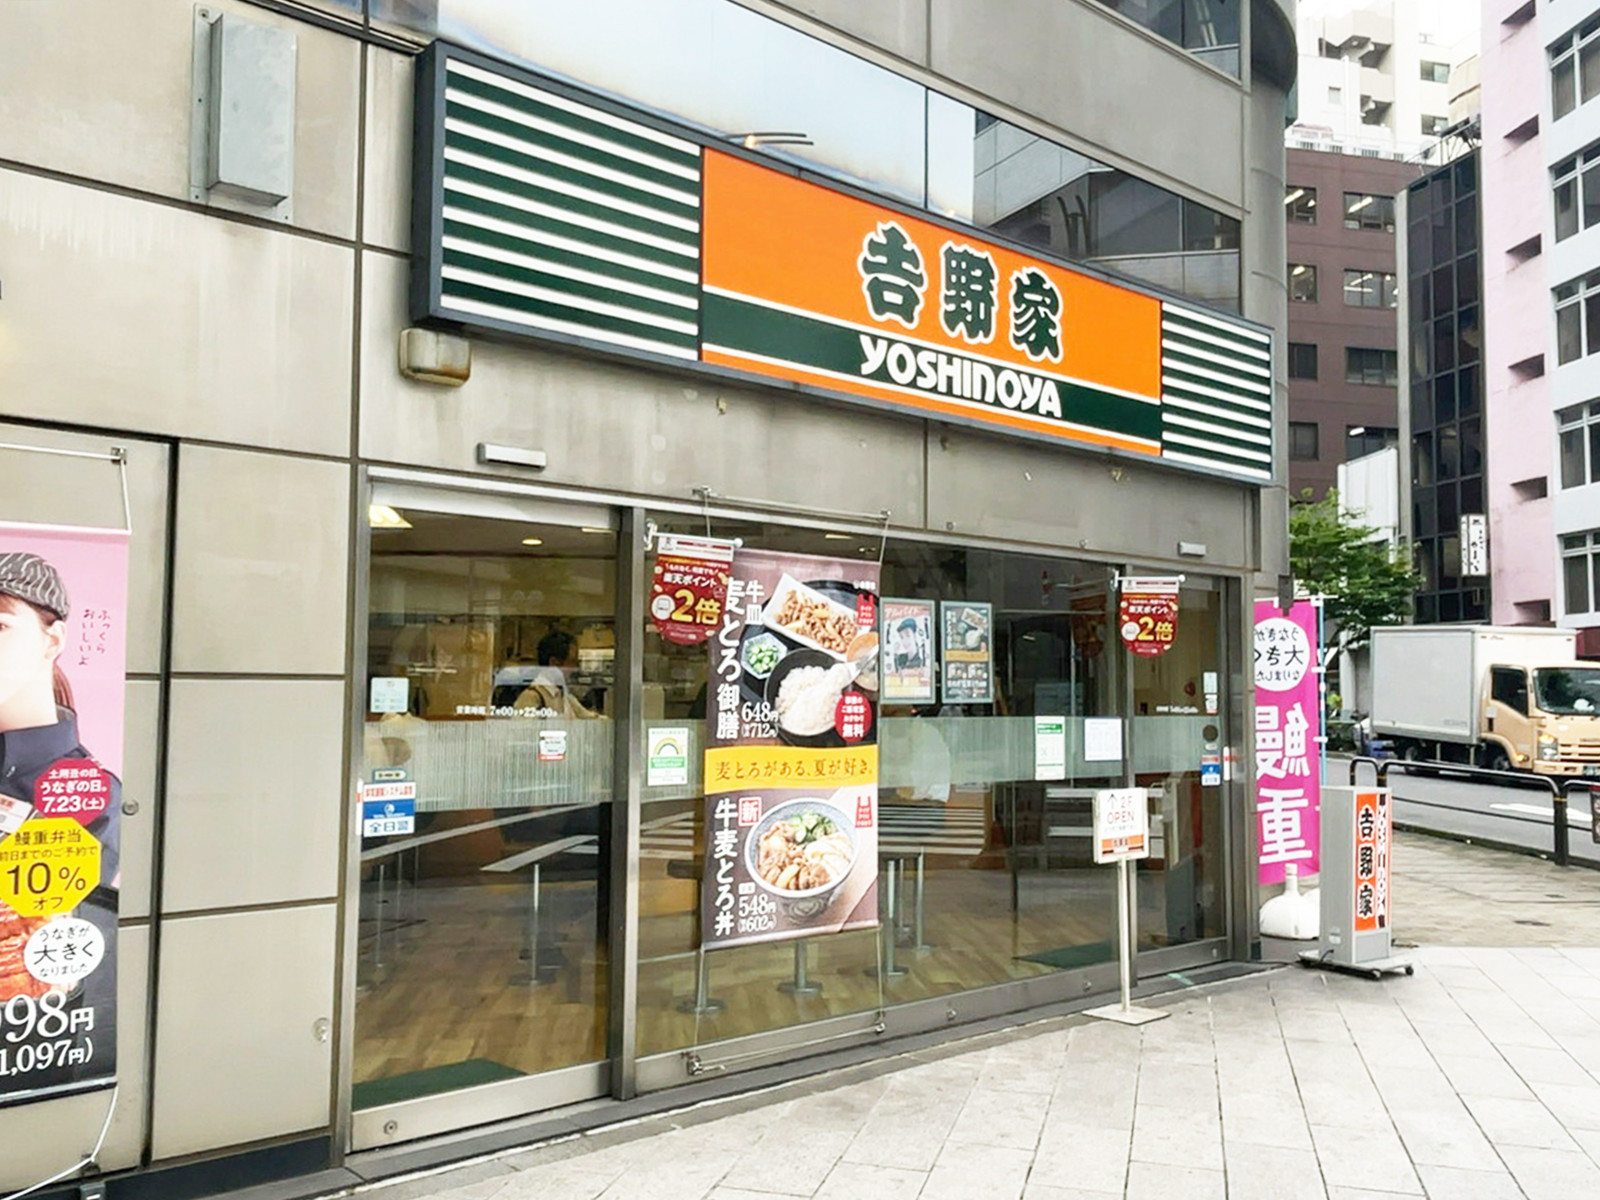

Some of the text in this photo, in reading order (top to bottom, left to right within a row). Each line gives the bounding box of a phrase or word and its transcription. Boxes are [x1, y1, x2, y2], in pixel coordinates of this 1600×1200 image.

[859, 334, 1062, 418] YOSHINOYA
[671, 589, 721, 625] 2倍
[745, 580, 765, 625] 牛皿
[78, 609, 96, 666] おいしいよ
[97, 609, 111, 654] ふっくら
[1138, 616, 1173, 641] 2倍
[715, 758, 873, 782] 麦とろがある、夏が好き。
[41, 780, 108, 795] うなぎの日。
[740, 799, 760, 825] 新
[1107, 810, 1134, 825] OPEN
[15, 829, 81, 846] 鰻重弁当
[714, 798, 739, 937] 牛麦とろ丼
[33, 896, 64, 912] オフ
[39, 926, 91, 943] うなぎが
[33, 941, 93, 965] 大きく
[39, 963, 90, 978] なりました
[0, 990, 94, 1043] 98円
